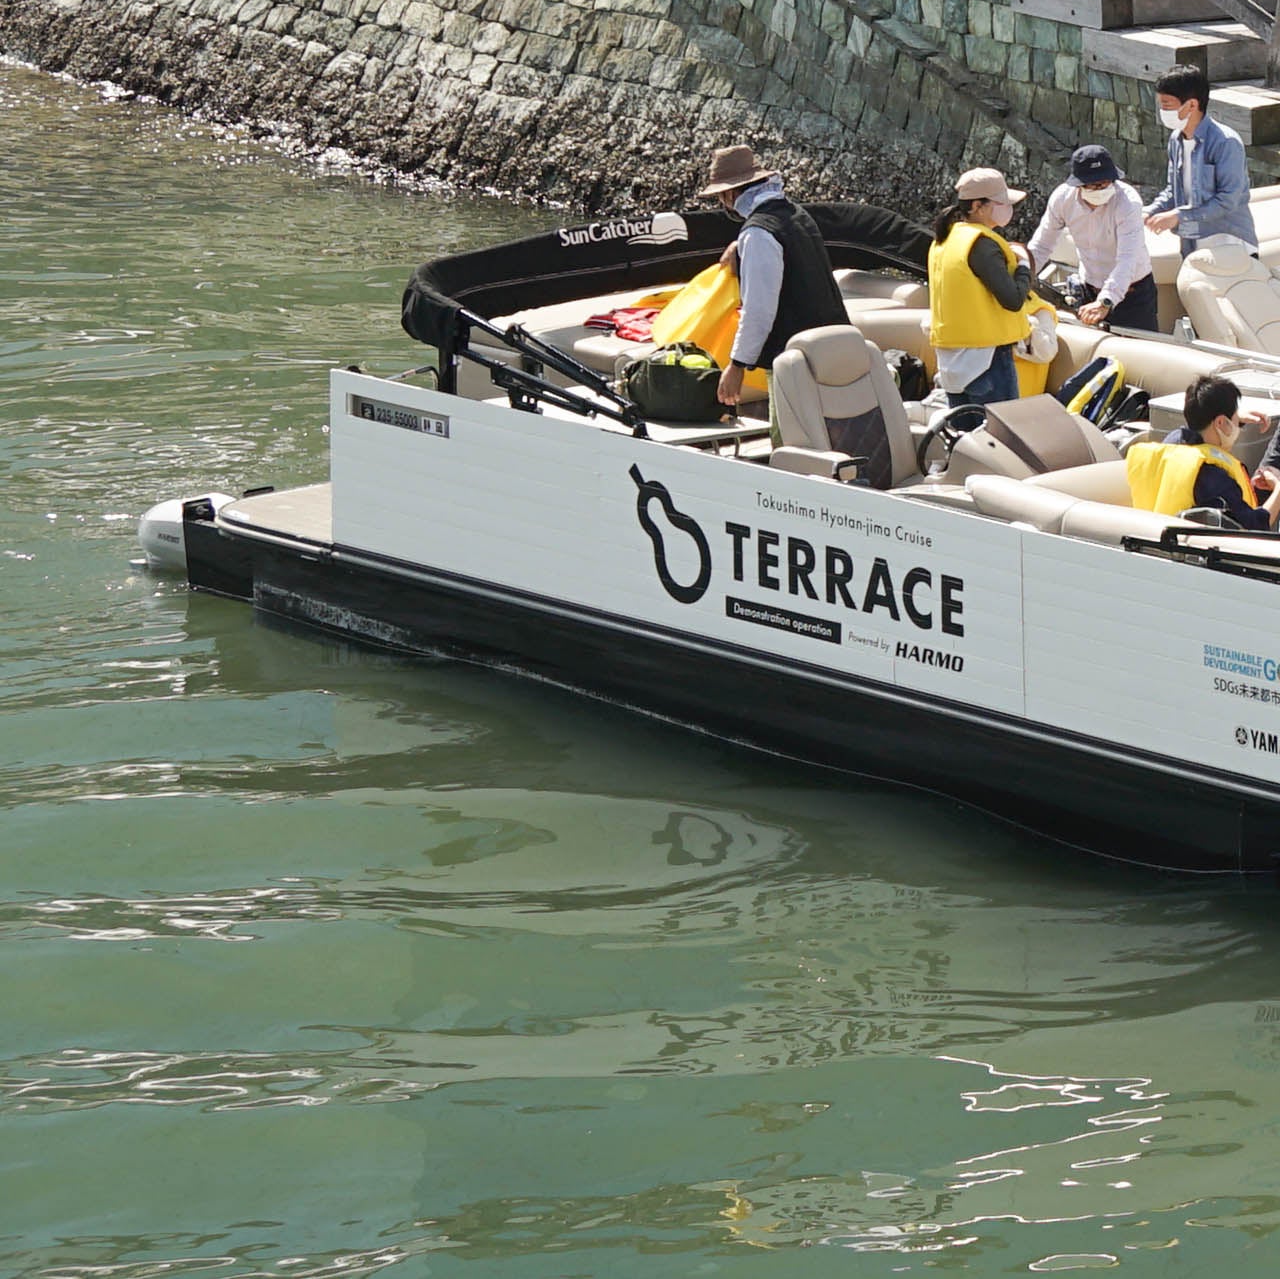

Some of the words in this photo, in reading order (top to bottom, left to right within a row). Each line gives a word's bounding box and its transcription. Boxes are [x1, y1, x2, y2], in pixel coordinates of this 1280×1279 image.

[560, 219, 652, 247] SunCatcher
[756, 492, 815, 519] Tokushima
[821, 507, 890, 538] Hyotan-jima
[895, 526, 932, 547] Cruise
[726, 521, 964, 637] TERRACE
[733, 602, 791, 627] Demonstration
[792, 620, 832, 638] operation
[848, 631, 878, 648] Powered
[880, 638, 890, 652] by
[895, 641, 964, 673] HARMO
[1203, 644, 1263, 668] SUSTAINABLE
[1203, 656, 1263, 678] DEVELOPMENT
[1213, 677, 1280, 705] SDGs未来都市
